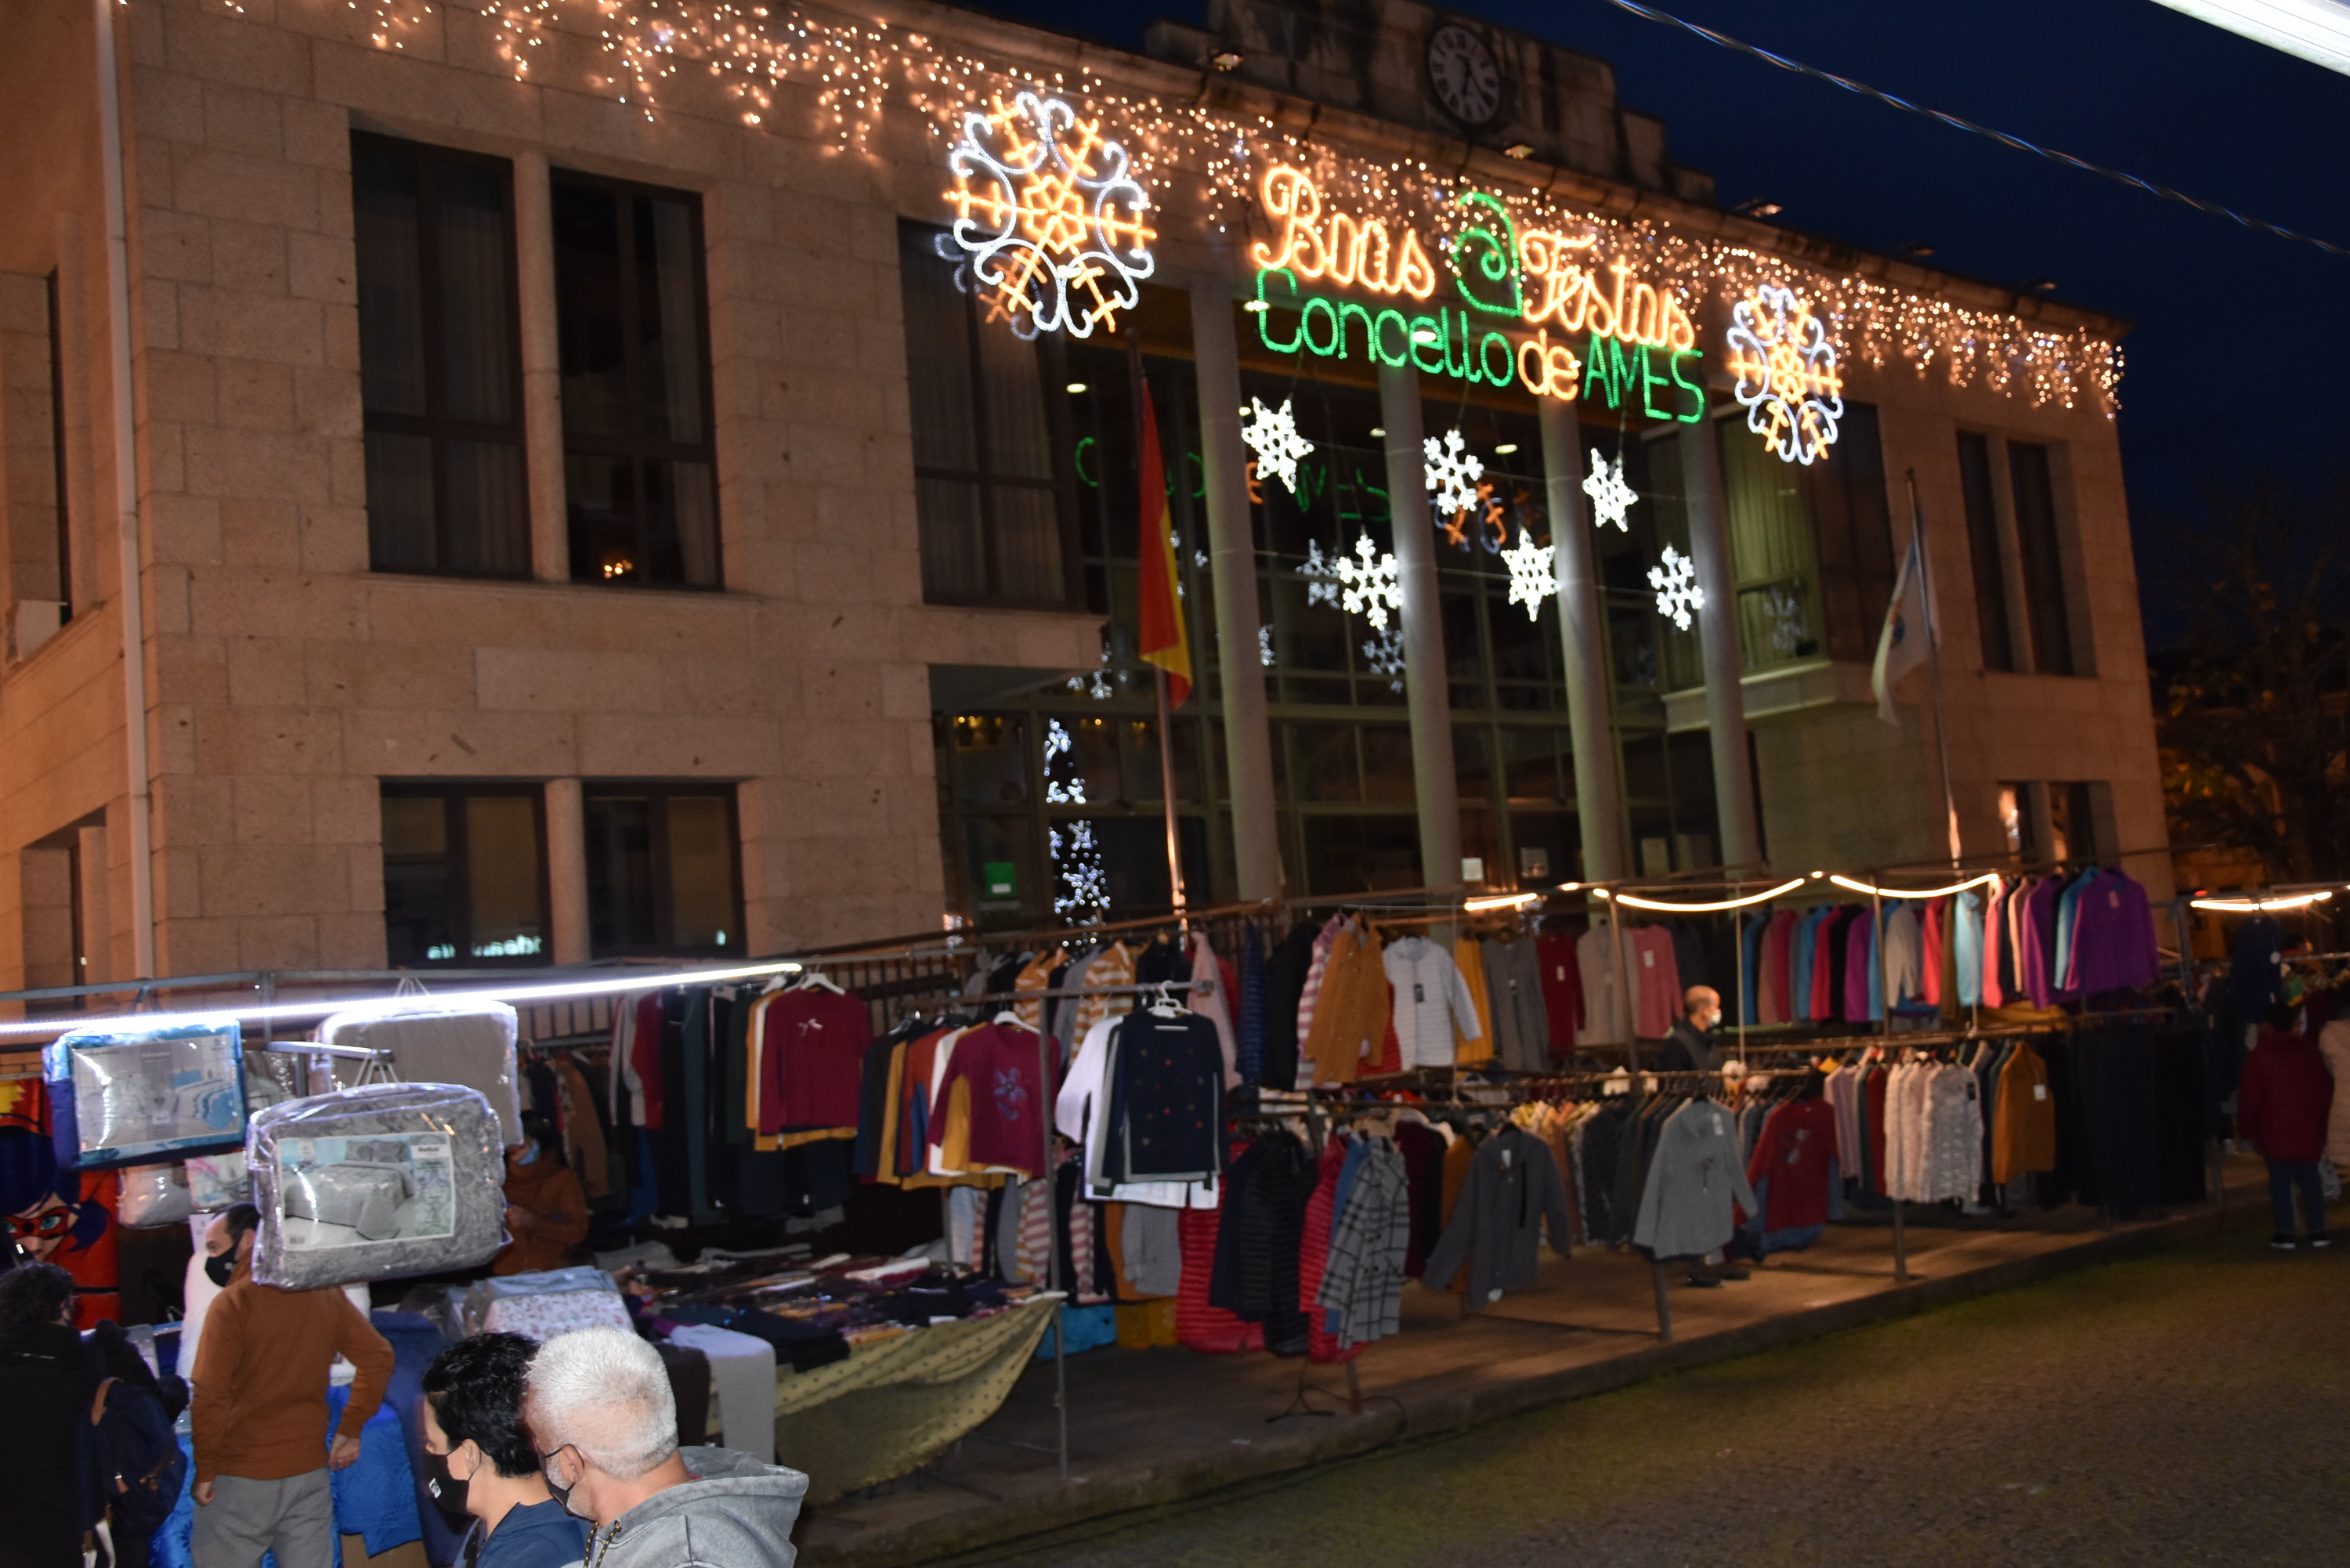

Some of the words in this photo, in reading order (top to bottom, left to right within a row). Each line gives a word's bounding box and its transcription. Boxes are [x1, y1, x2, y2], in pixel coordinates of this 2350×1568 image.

[1252, 165, 1437, 299] Boas
[1518, 229, 1695, 352] Festas
[1257, 267, 1514, 388] Concello
[1517, 327, 1581, 402] de
[1582, 331, 1705, 424] AMES
